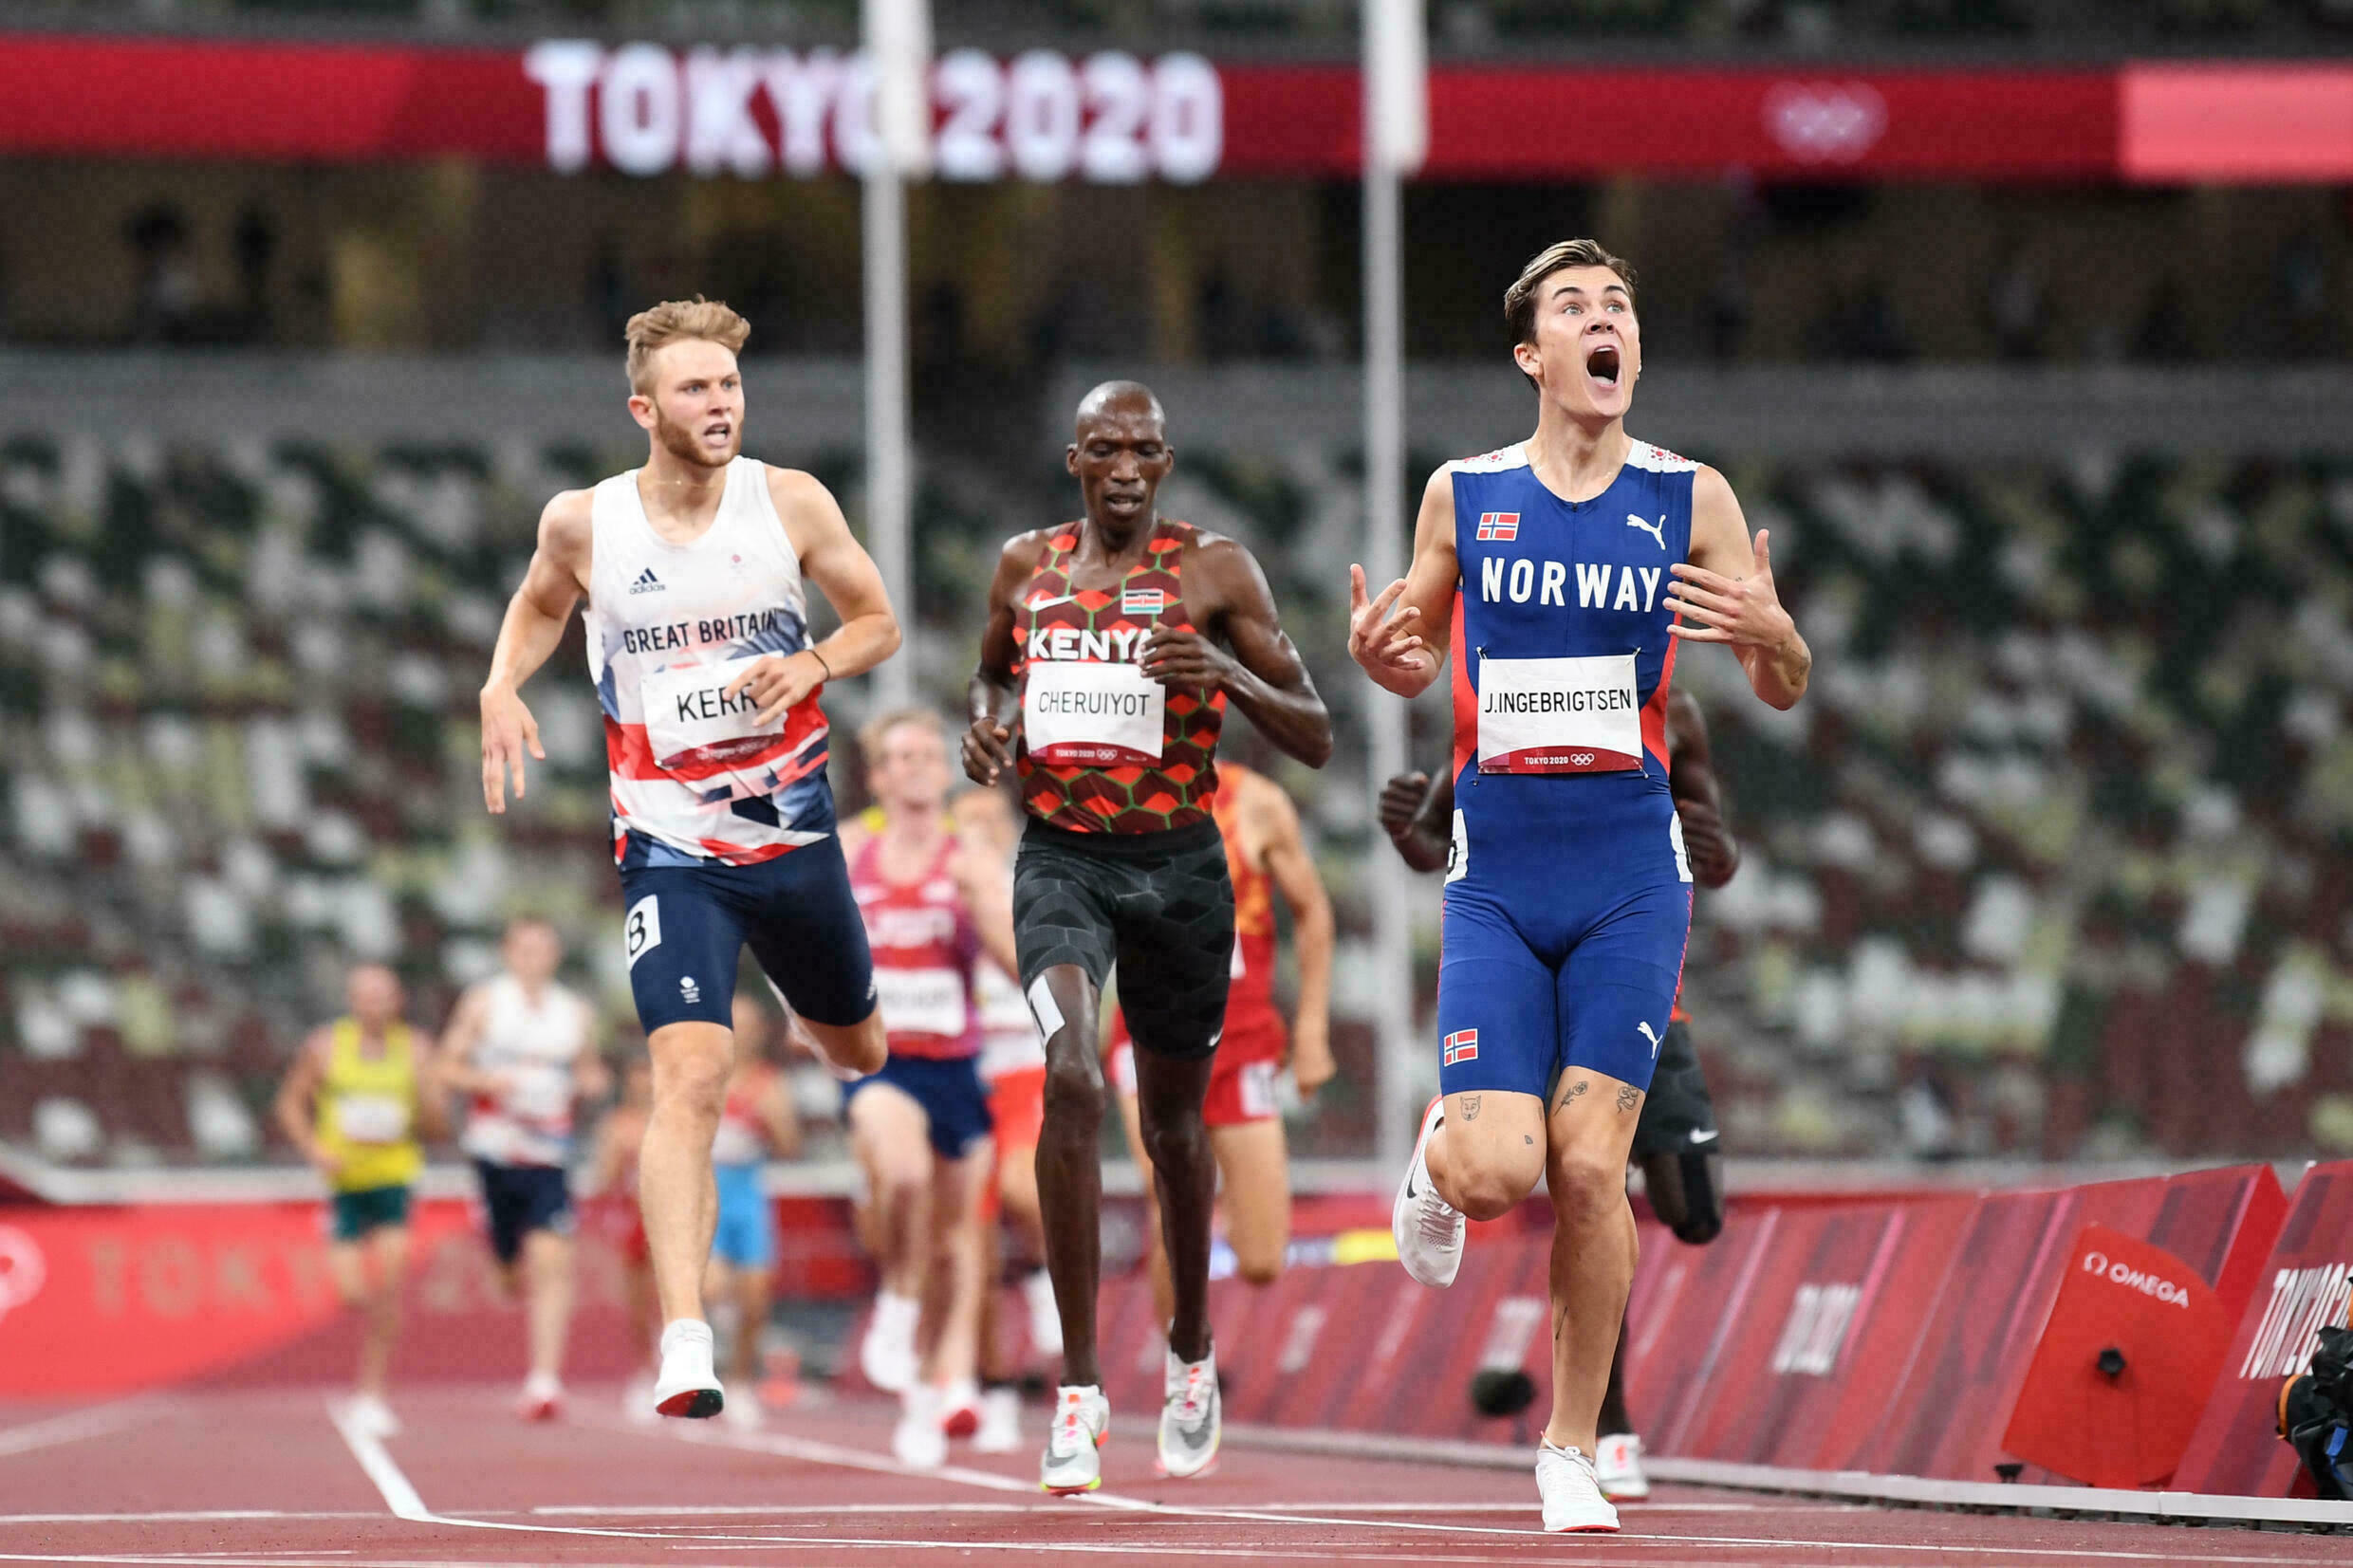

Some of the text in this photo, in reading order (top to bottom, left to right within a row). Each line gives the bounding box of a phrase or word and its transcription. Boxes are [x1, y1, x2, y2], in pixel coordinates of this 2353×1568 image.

[934, 47, 1224, 184] 2020
[628, 581, 667, 595] adidas
[1481, 556, 1662, 613] NORWAY
[623, 608, 779, 655] GREAT BRITAIN
[1038, 691, 1151, 717] CHERUIYOT
[1484, 688, 1633, 714] J.INGEBRIGTSEN
[1524, 755, 1568, 766] TOKYO 2020
[629, 911, 646, 957] 8
[2108, 1262, 2190, 1309] OMEGA
